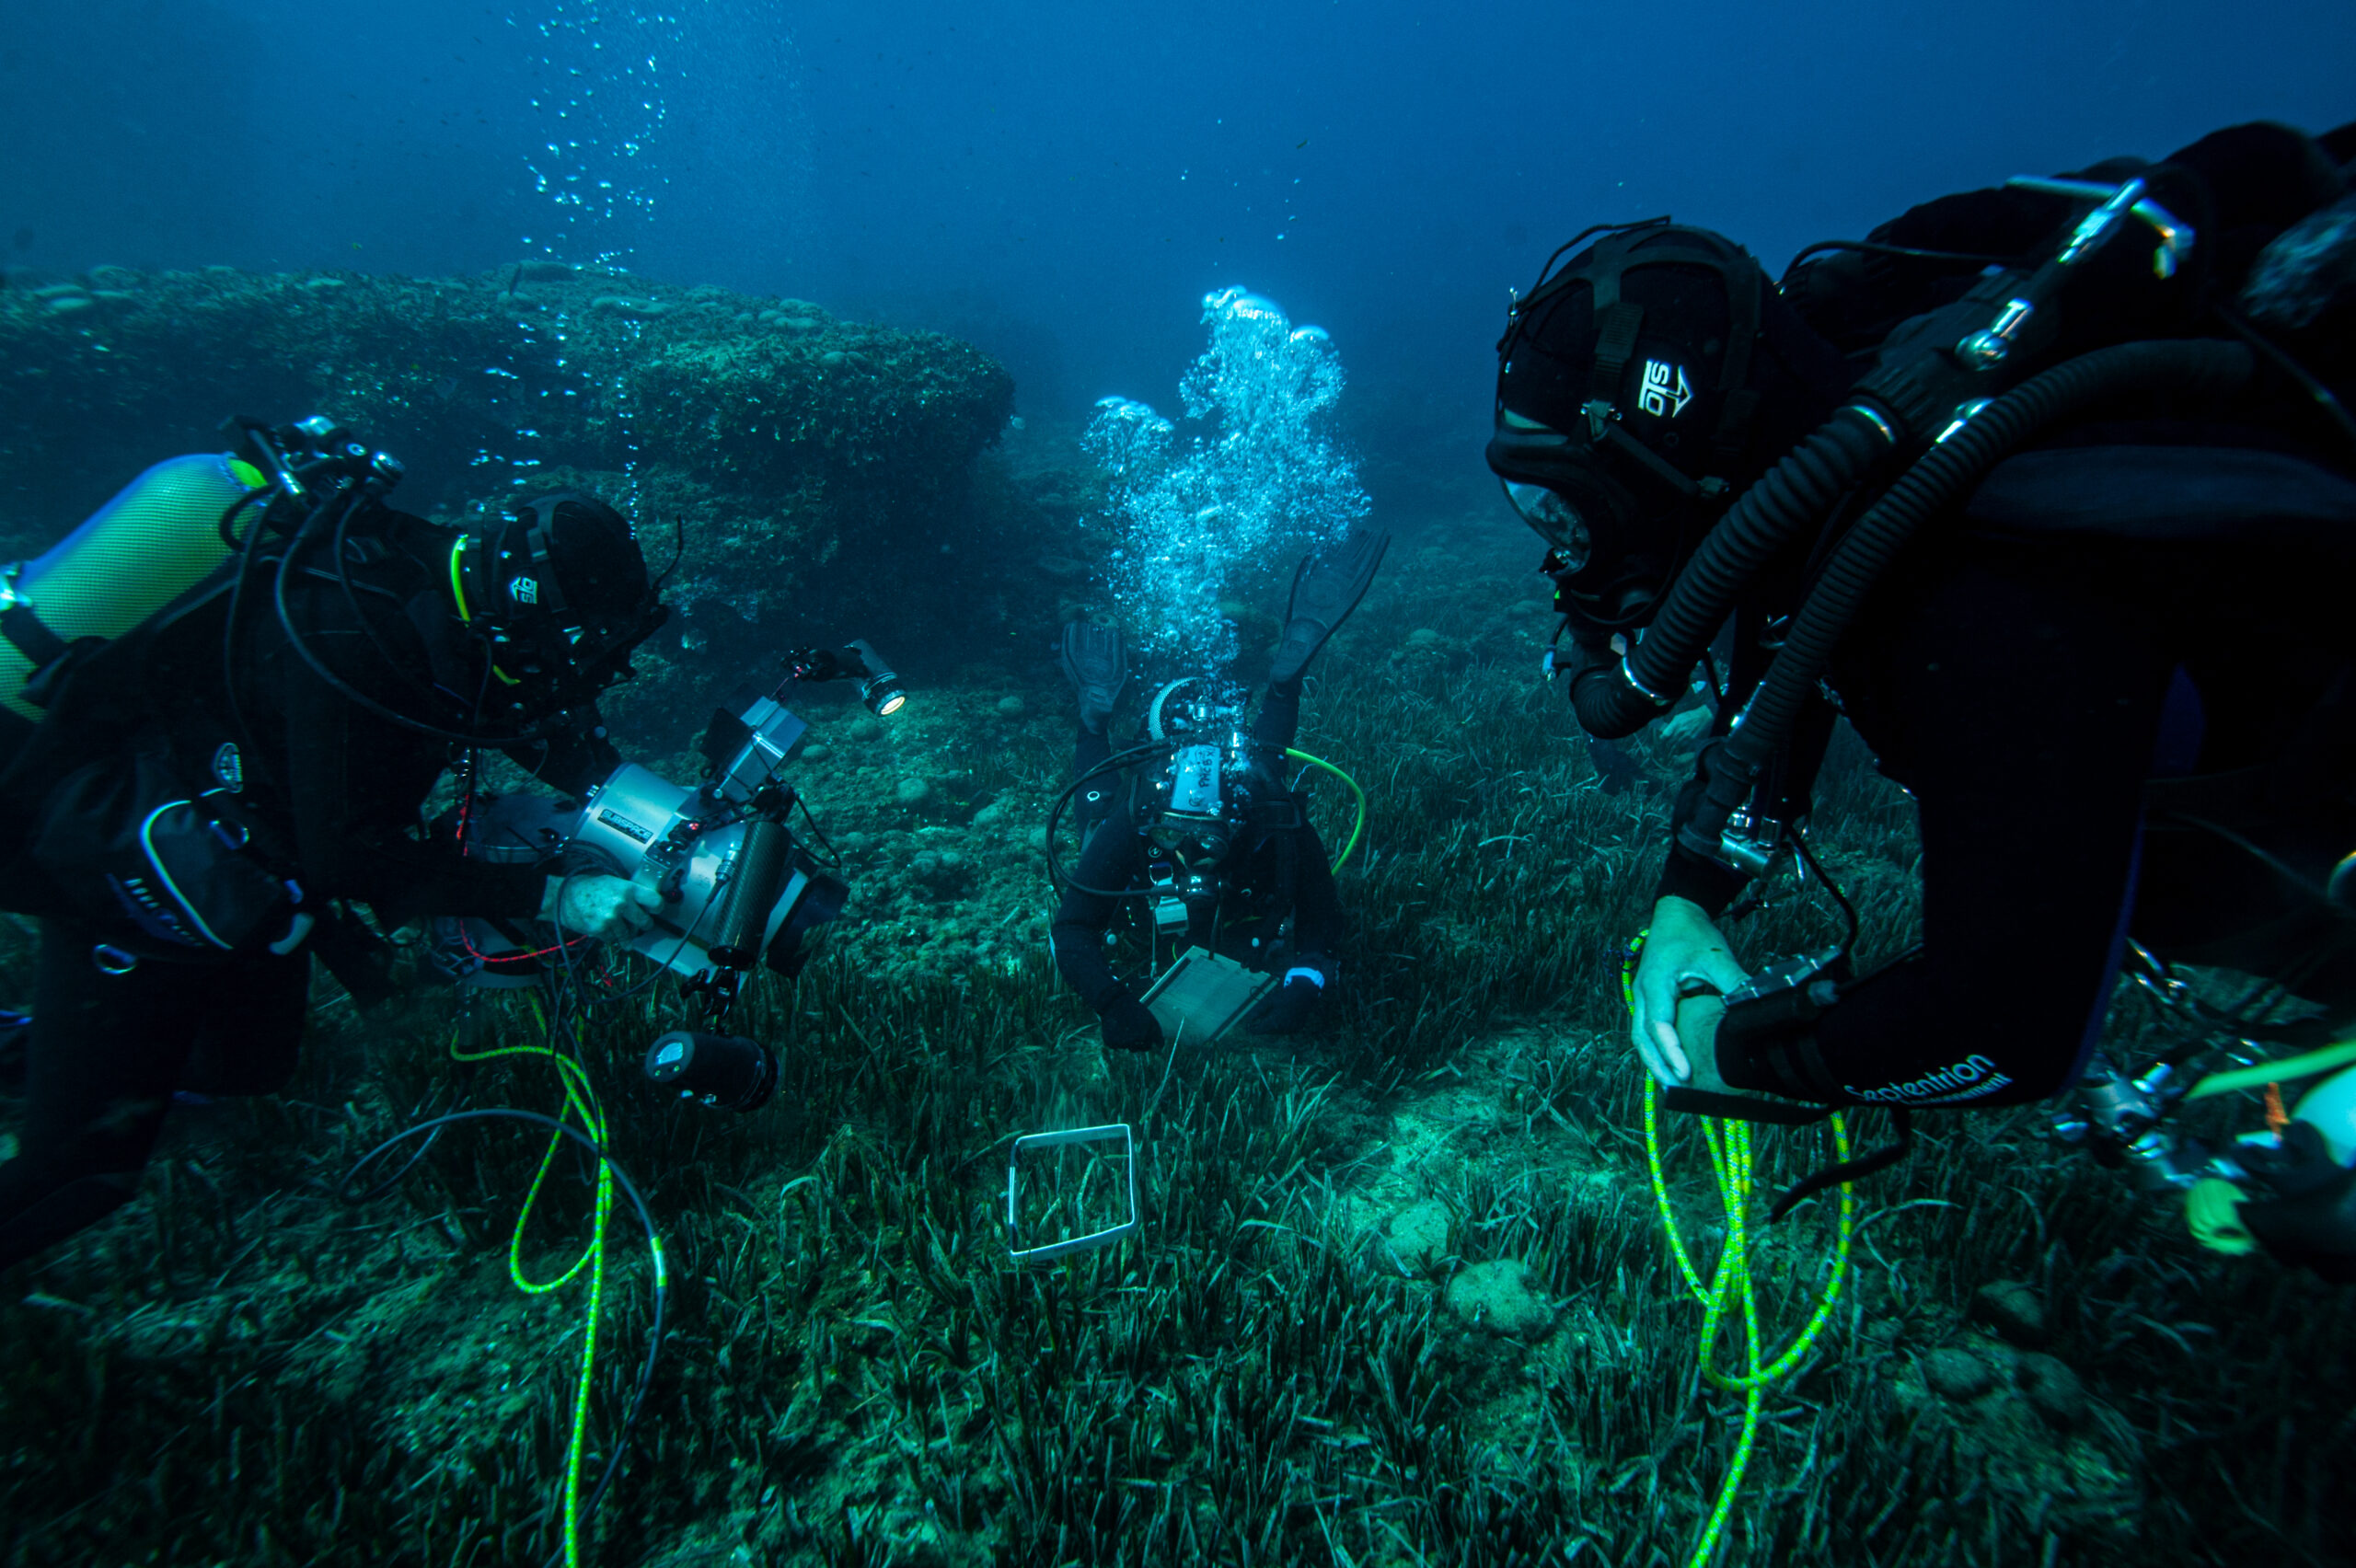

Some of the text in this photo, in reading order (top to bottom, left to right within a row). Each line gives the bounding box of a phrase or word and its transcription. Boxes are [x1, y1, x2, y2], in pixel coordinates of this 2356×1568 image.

[1638, 360, 1679, 417] OTS
[602, 810, 653, 840] SUBSPACE
[1843, 1054, 1995, 1102] Septentrion
